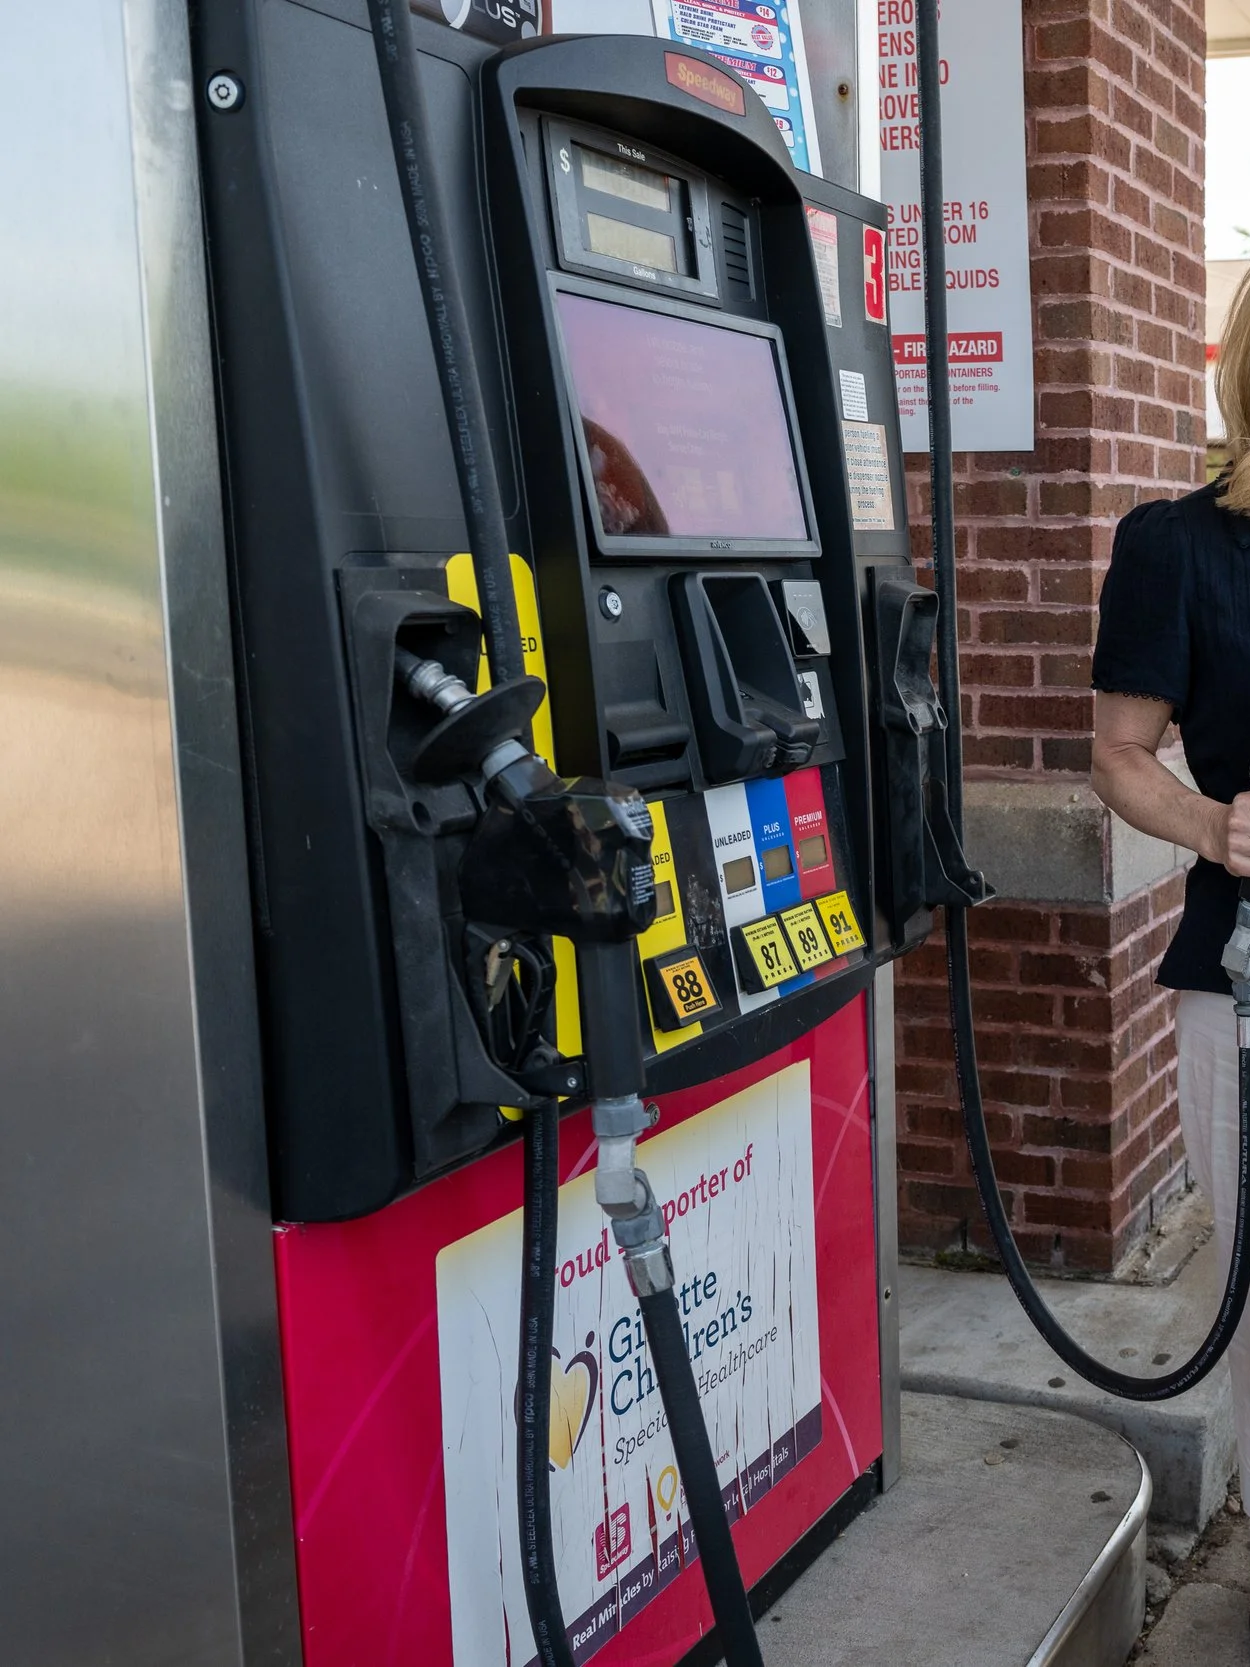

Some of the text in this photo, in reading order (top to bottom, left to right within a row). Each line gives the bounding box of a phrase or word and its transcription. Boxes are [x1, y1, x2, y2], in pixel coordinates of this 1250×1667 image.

[759, 6, 771, 17] $14
[767, 67, 777, 77] $12
[905, 60, 949, 87] INO
[677, 61, 736, 107] Speedway
[400, 120, 413, 145] USA
[403, 148, 415, 160] IN
[559, 147, 571, 175] $
[617, 142, 646, 162] This Sale
[409, 165, 424, 196] MADE
[901, 202, 962, 223] UNER
[969, 201, 989, 220] 16
[888, 224, 977, 247] TED OM
[890, 251, 920, 269] ING
[633, 265, 656, 281] Gallons
[864, 228, 885, 320] 3
[889, 268, 1000, 291] BLE QUIDS
[904, 342, 926, 358] FIR
[948, 340, 998, 356] AZARD
[894, 367, 993, 380] PORTAB NTAINERS
[913, 385, 924, 393] the
[953, 383, 976, 392] before
[977, 383, 1001, 393] filling.
[899, 397, 916, 406] ainst
[953, 397, 959, 405] of
[962, 396, 974, 405] the
[863, 458, 887, 469] attendance
[794, 810, 822, 826] PREMIUM
[763, 822, 780, 835] PLUS
[715, 830, 751, 848] UNLEADED
[829, 910, 852, 935] 91
[798, 927, 818, 954] 89
[836, 934, 859, 948] PRESS
[760, 941, 782, 970] 87
[802, 948, 828, 964] PRESS
[764, 965, 793, 980] PRESS
[672, 970, 703, 1002] 88
[556, 1143, 754, 1288] oud porter of
[529, 1317, 538, 1334] USA
[608, 1271, 717, 1363] Gitte
[528, 1335, 537, 1343] IN
[527, 1346, 537, 1369] MADE
[610, 1290, 753, 1416] Chren's
[698, 1326, 778, 1399] Healthcare
[526, 1429, 535, 1437] BY
[714, 1450, 730, 1468] work
[525, 1483, 535, 1507] ULTRA
[526, 1508, 537, 1550] STEELFLEX
[572, 1620, 597, 1651] Real
[641, 1567, 654, 1588] by
[538, 1620, 549, 1637] USA
[540, 1637, 550, 1646] IN
